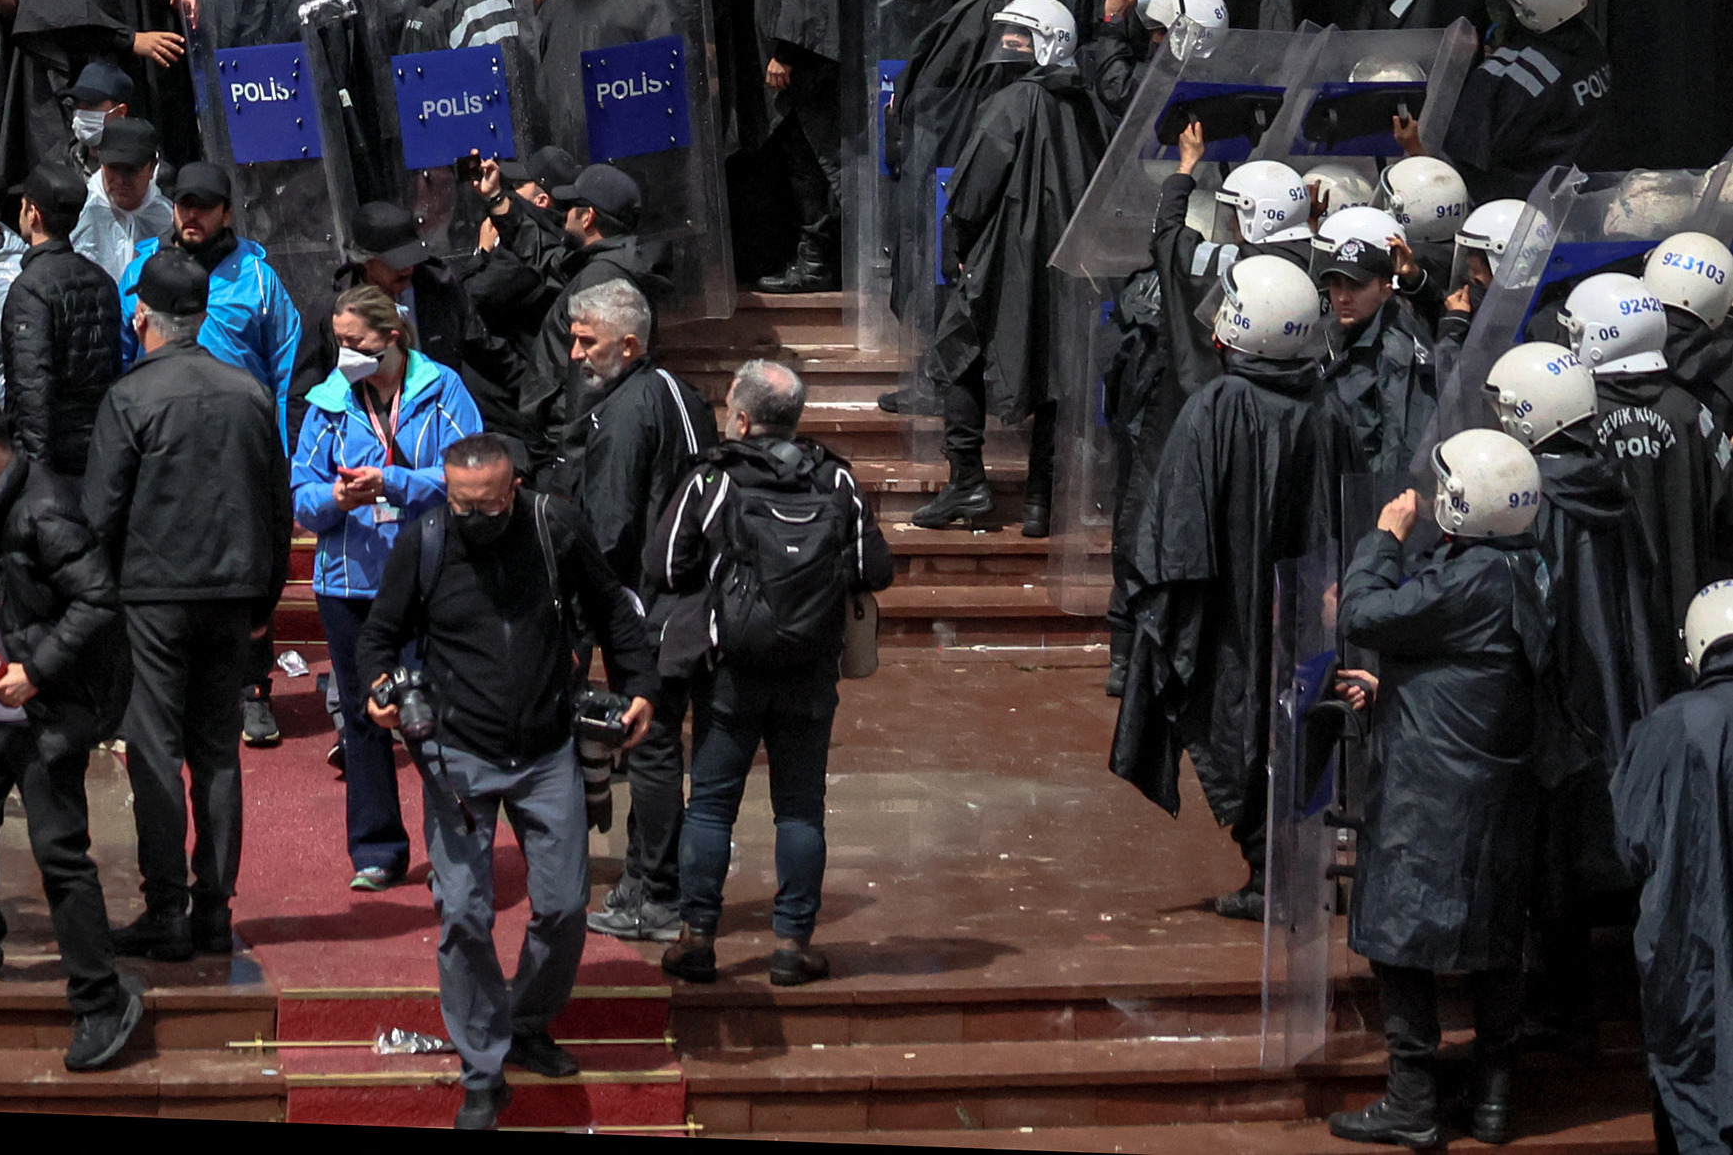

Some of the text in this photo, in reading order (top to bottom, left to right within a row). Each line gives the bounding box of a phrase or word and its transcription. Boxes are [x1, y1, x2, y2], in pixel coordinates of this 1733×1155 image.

[1059, 30, 1071, 43] 06
[230, 76, 290, 104] POLİS
[595, 71, 663, 103] POLİS
[422, 91, 484, 120] POLİS
[1267, 208, 1286, 222] 06
[1661, 251, 1726, 286] 923103
[1233, 313, 1251, 330] 06
[1599, 325, 1620, 341] 06
[1514, 399, 1533, 419] 06
[1451, 496, 1470, 515] 06
